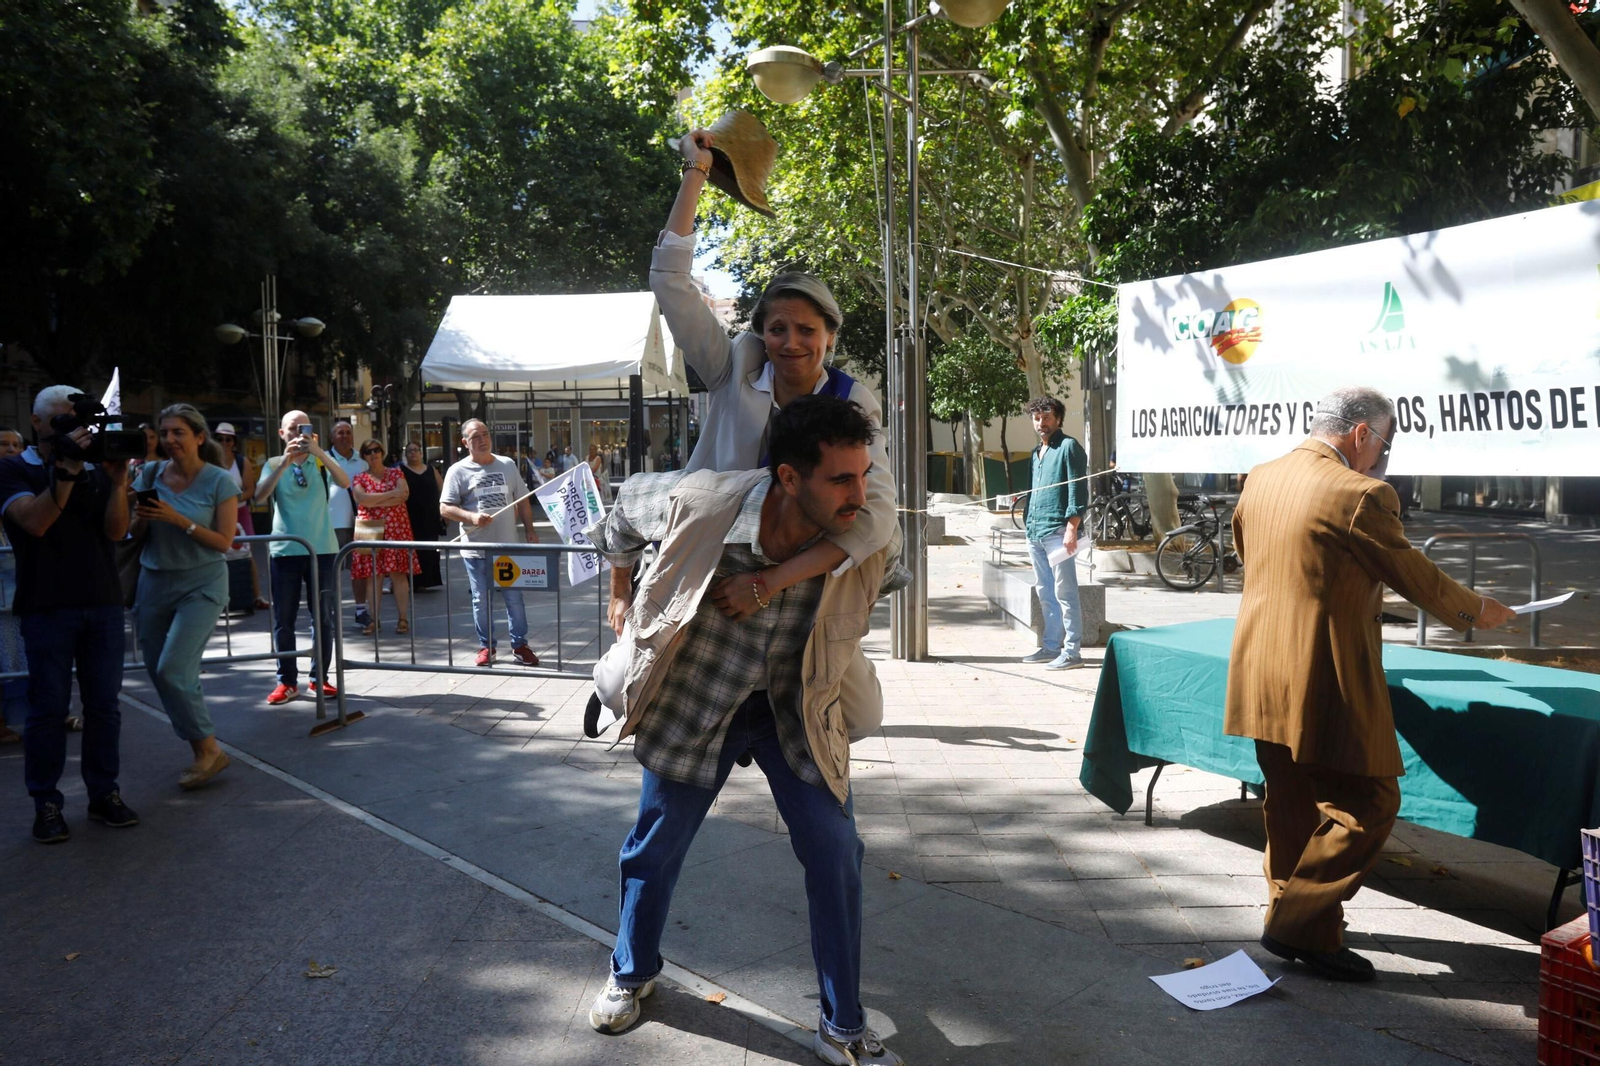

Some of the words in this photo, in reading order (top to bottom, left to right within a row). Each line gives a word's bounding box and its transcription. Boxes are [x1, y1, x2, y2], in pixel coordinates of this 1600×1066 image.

[1174, 307, 1259, 341] COAG
[1131, 408, 1157, 438] LOS
[1160, 402, 1282, 438] AGRICULTORES
[1286, 402, 1297, 435] Y
[1438, 389, 1543, 432] HARTOS
[1549, 386, 1588, 429] DE
[567, 480, 588, 525] PRECIOS
[586, 491, 600, 514] UPA
[572, 532, 594, 569] CAPO
[521, 568, 547, 576] BAREA
